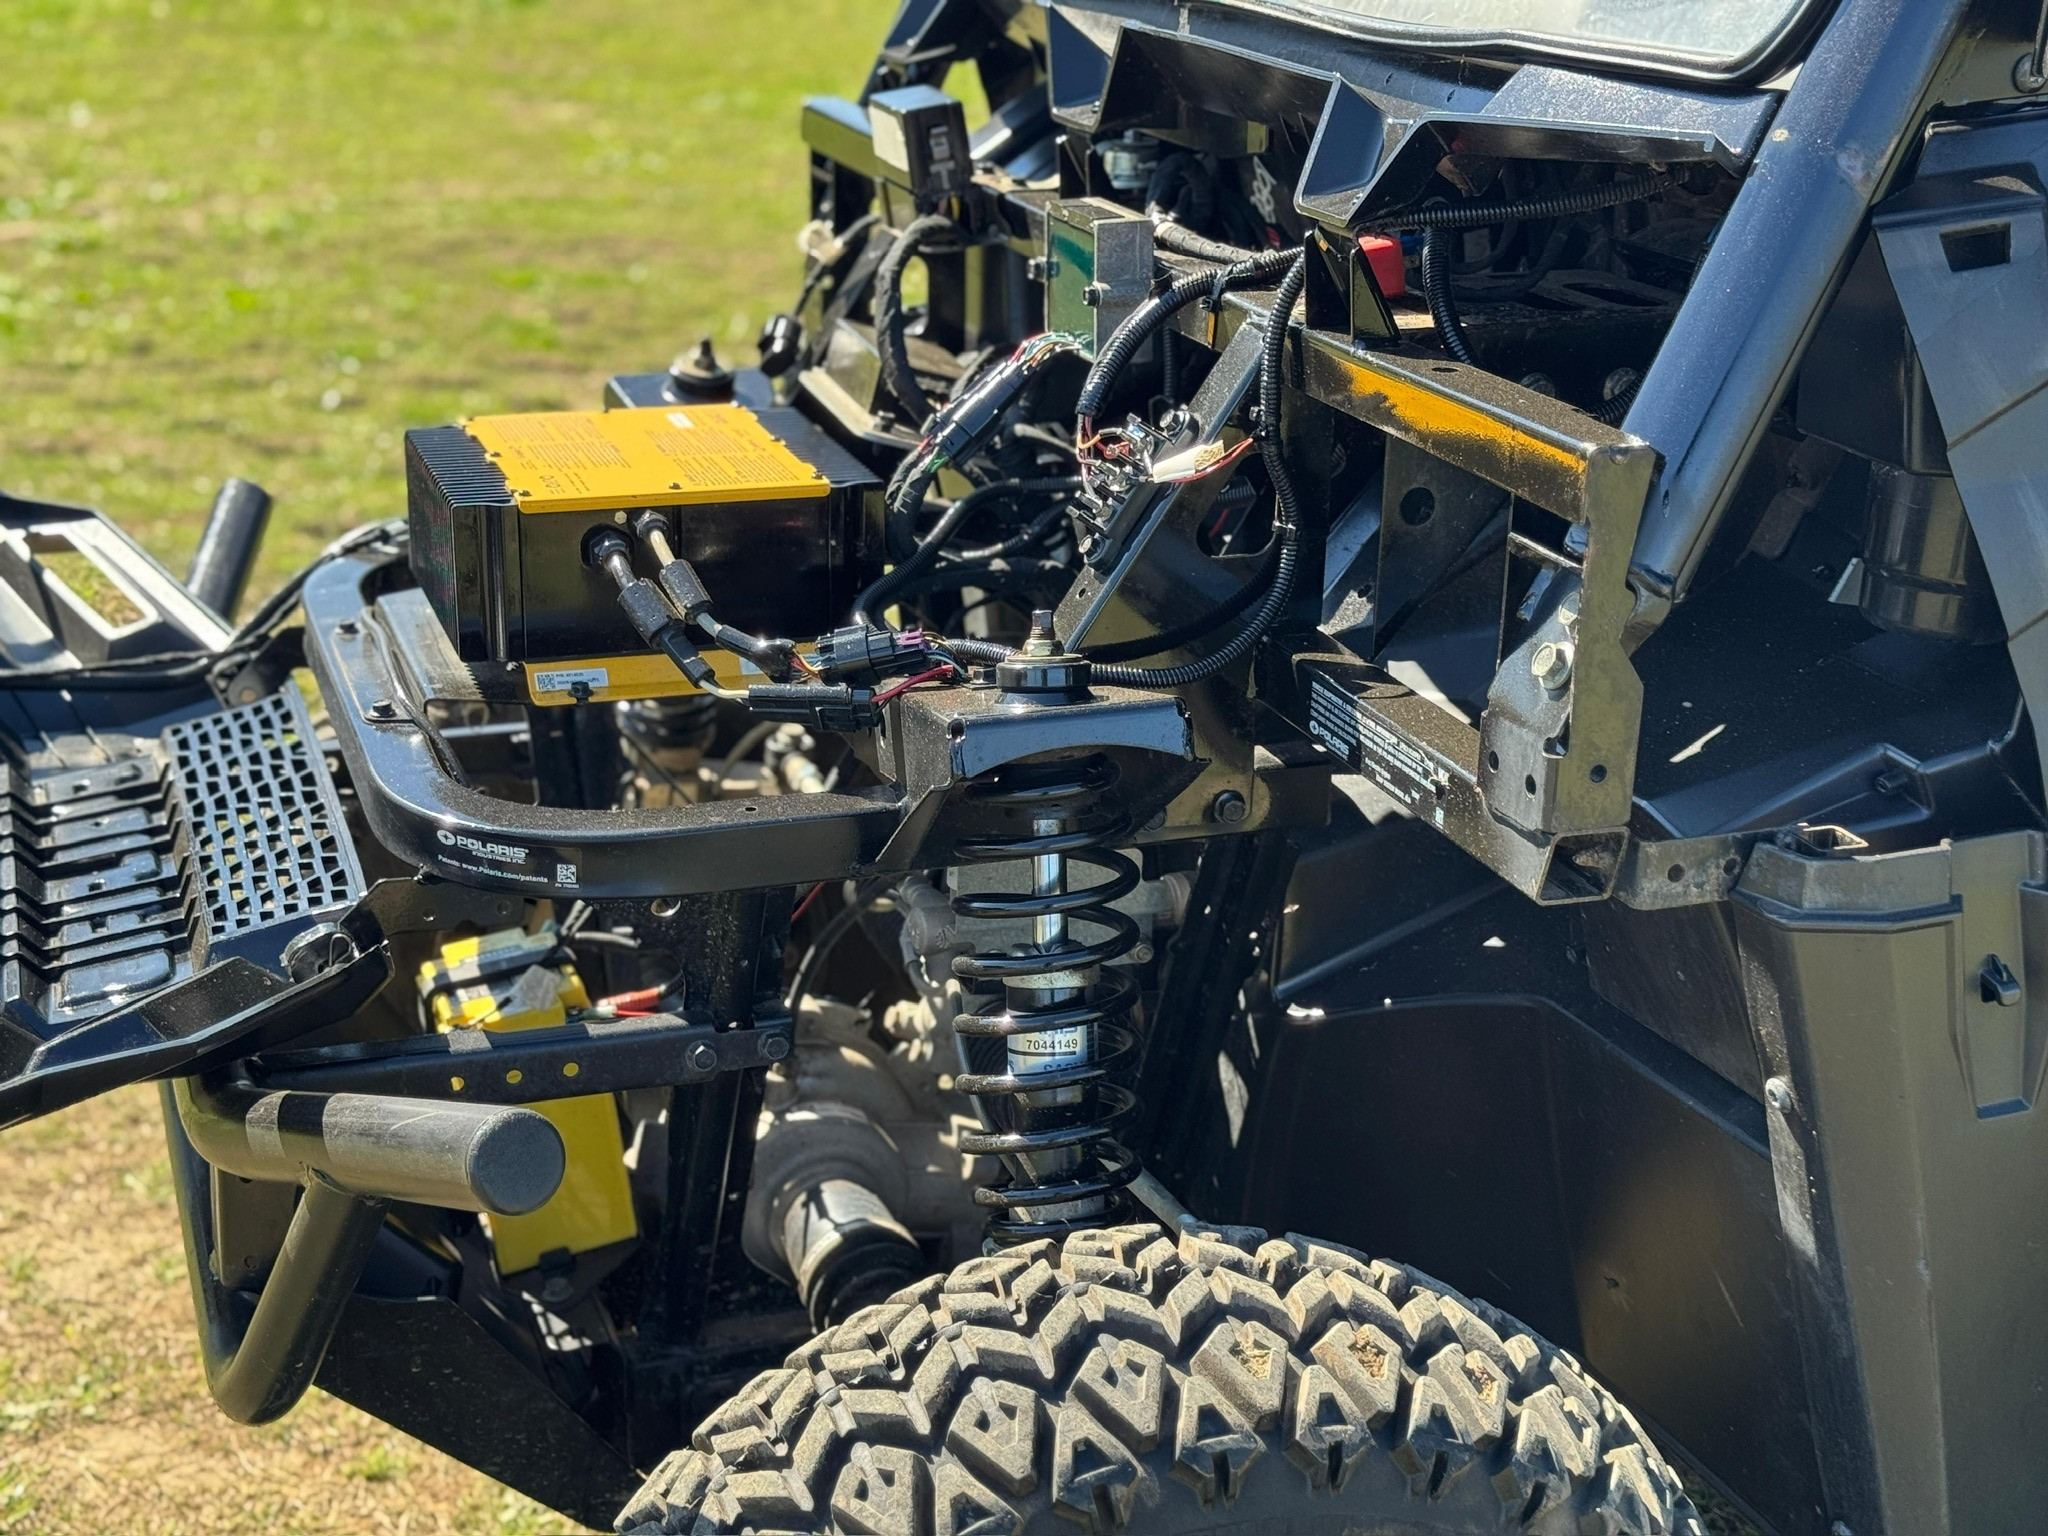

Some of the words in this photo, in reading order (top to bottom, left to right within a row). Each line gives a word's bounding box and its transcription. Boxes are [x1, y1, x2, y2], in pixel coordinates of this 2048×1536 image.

[1319, 726, 1349, 755] POLARIS
[456, 835, 527, 858] POLARIS
[1026, 1038, 1078, 1050] 7044149
